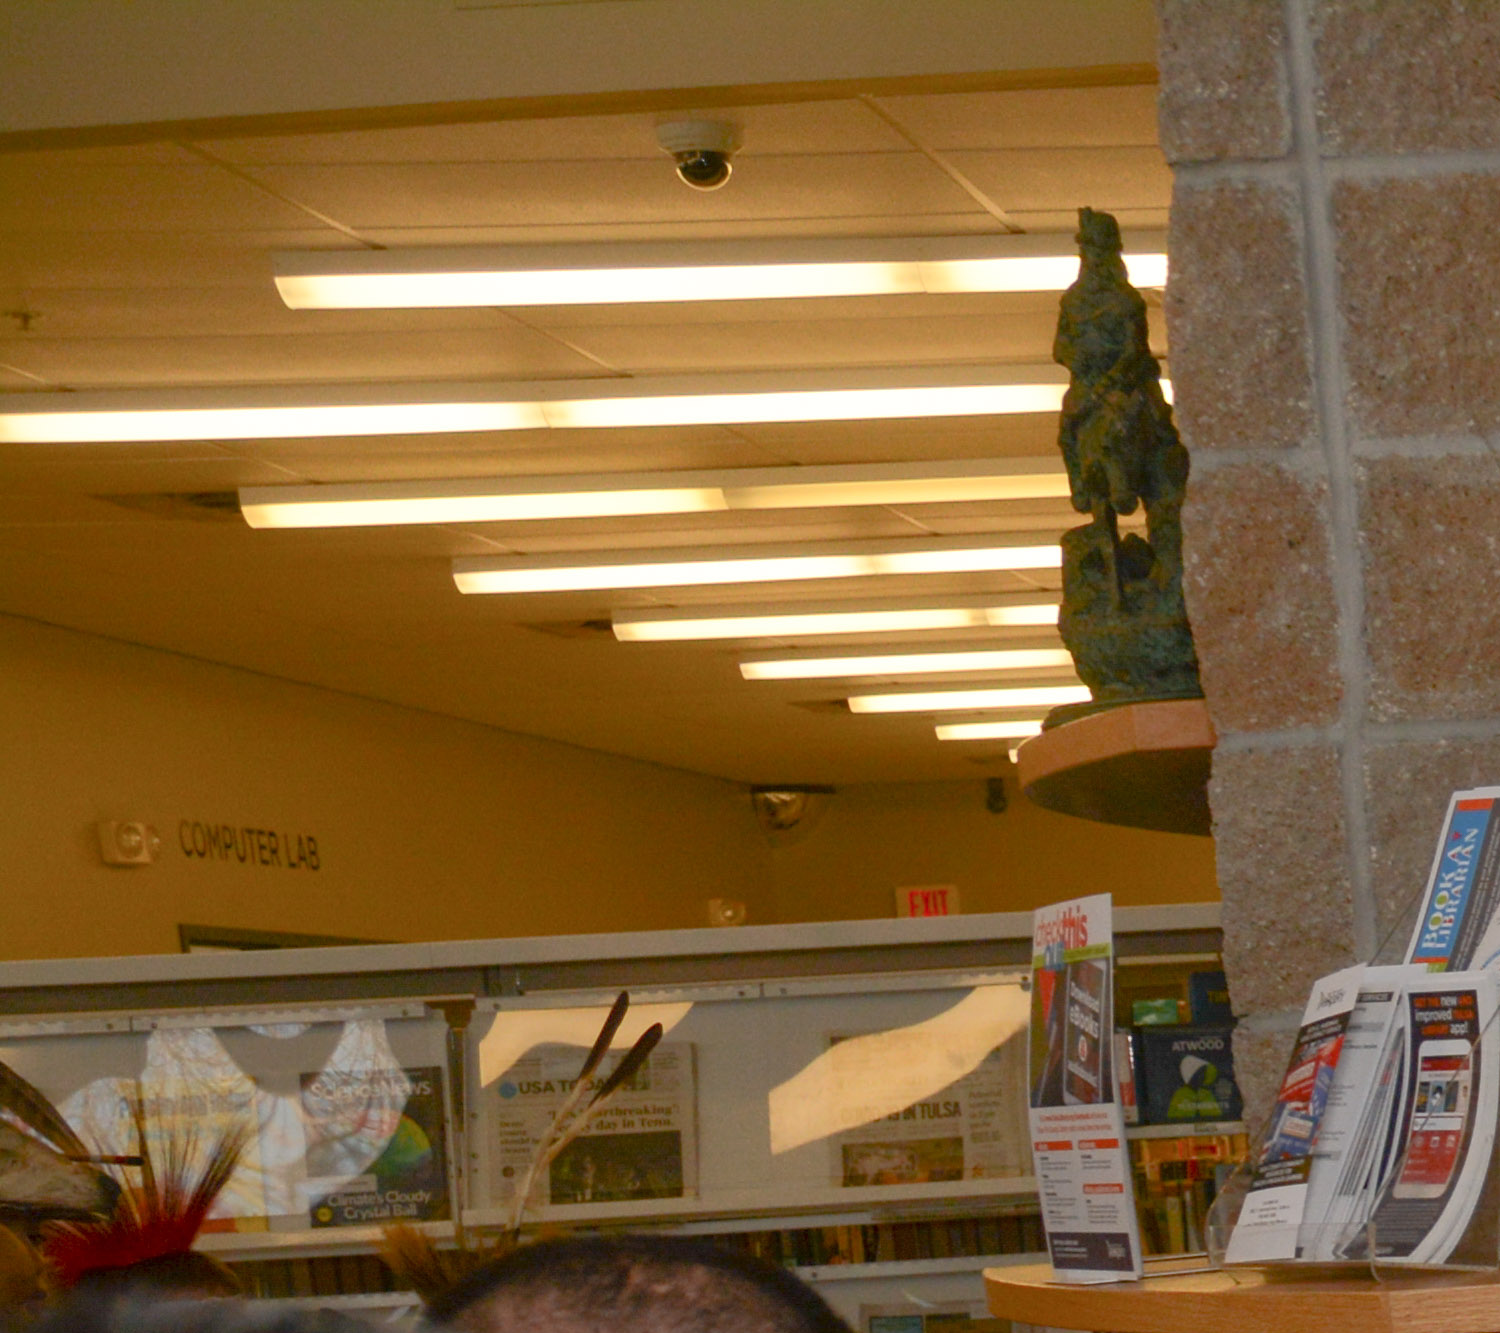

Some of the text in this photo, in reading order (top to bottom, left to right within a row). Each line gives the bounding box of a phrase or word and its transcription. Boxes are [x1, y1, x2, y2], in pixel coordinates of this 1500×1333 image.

[178, 819, 321, 871] COMPUTER LAB
[1433, 826, 1480, 949] LIBRARIAN
[907, 889, 949, 918] EXIT
[1421, 871, 1455, 949] BOOK
[1062, 905, 1089, 950] this
[1440, 996, 1457, 1008] new
[1415, 1008, 1452, 1023] improved
[1171, 1039, 1225, 1051] ATWOOD
[518, 1080, 556, 1095] USA
[919, 1101, 963, 1121] TULSA
[622, 1117, 636, 1129] in
[385, 1189, 432, 1205] Cloudy
[343, 1200, 419, 1219] Crystal Ball
